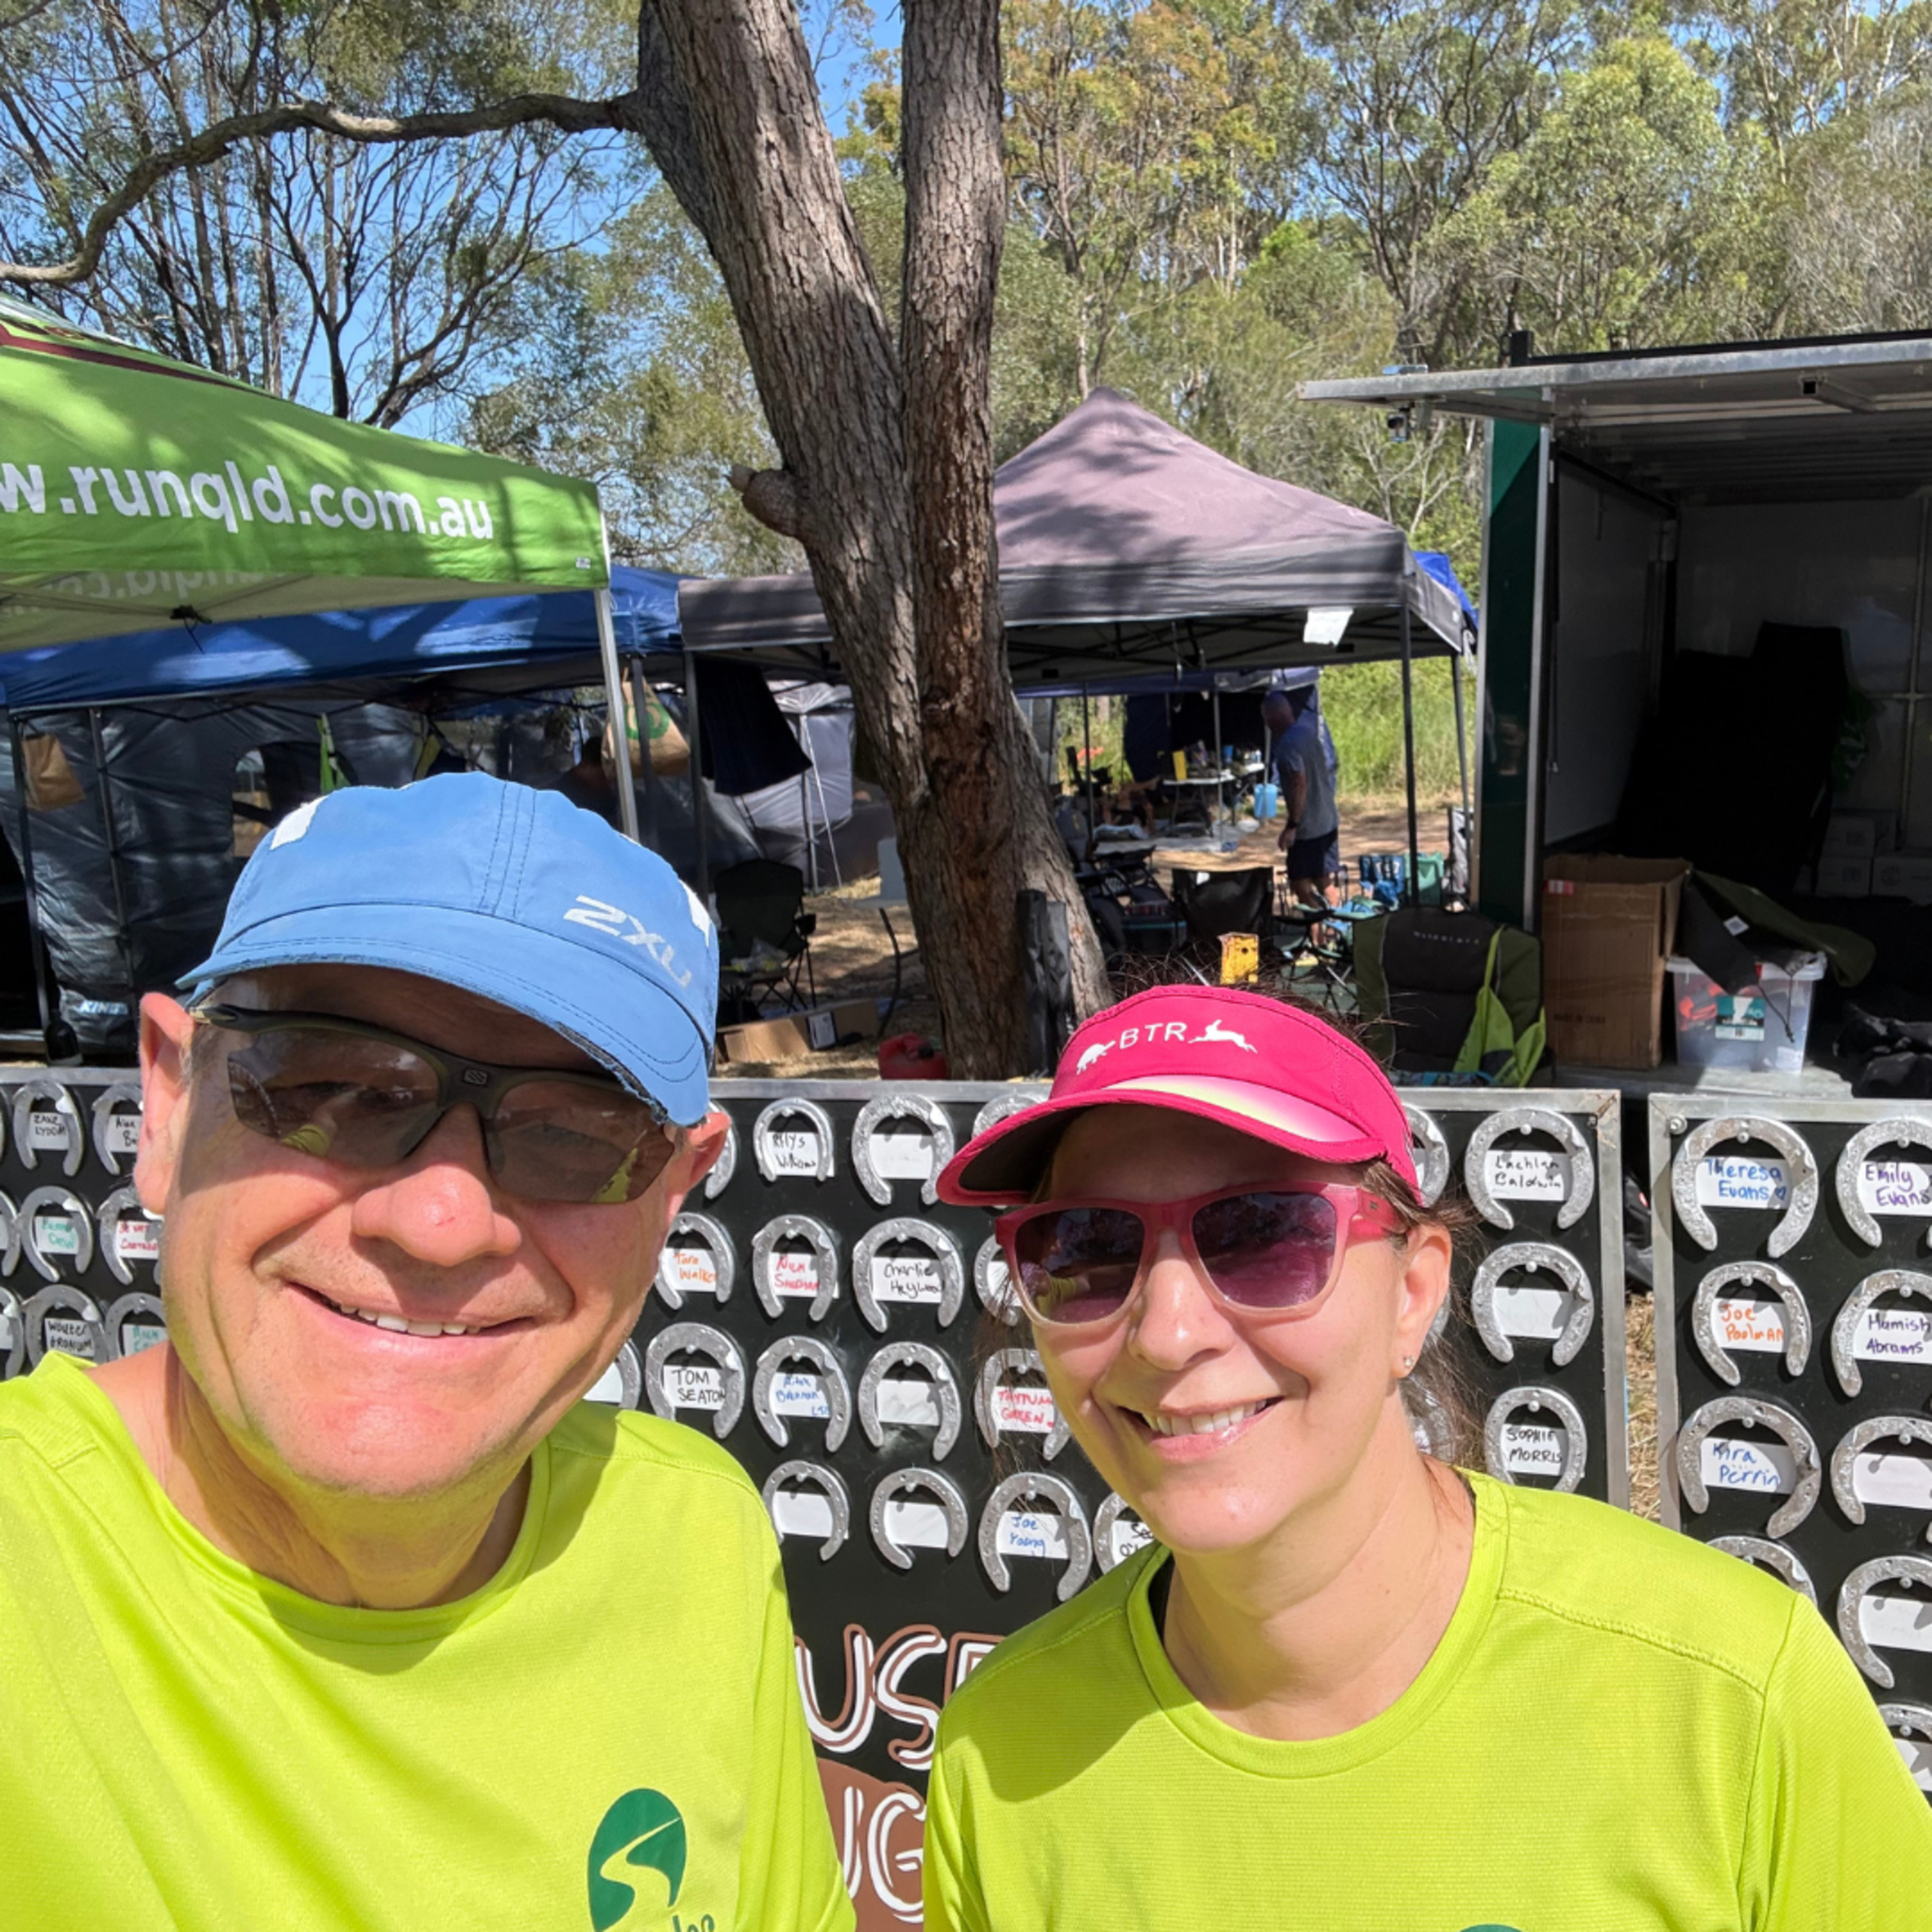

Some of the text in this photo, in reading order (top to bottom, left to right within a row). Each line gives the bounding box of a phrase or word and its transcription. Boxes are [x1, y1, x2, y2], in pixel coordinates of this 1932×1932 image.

[1119, 1022, 1188, 1049] BTR
[1705, 1157, 1783, 1182] Theresa
[1865, 1159, 1914, 1193] Emily
[1718, 1179, 1770, 1200] Evans
[1876, 1186, 1931, 1208] Evans
[884, 1262, 935, 1278] Charlie
[1868, 1312, 1931, 1333] Hamish
[1866, 1338, 1924, 1355] Abrams
[672, 1368, 710, 1386] TOM
